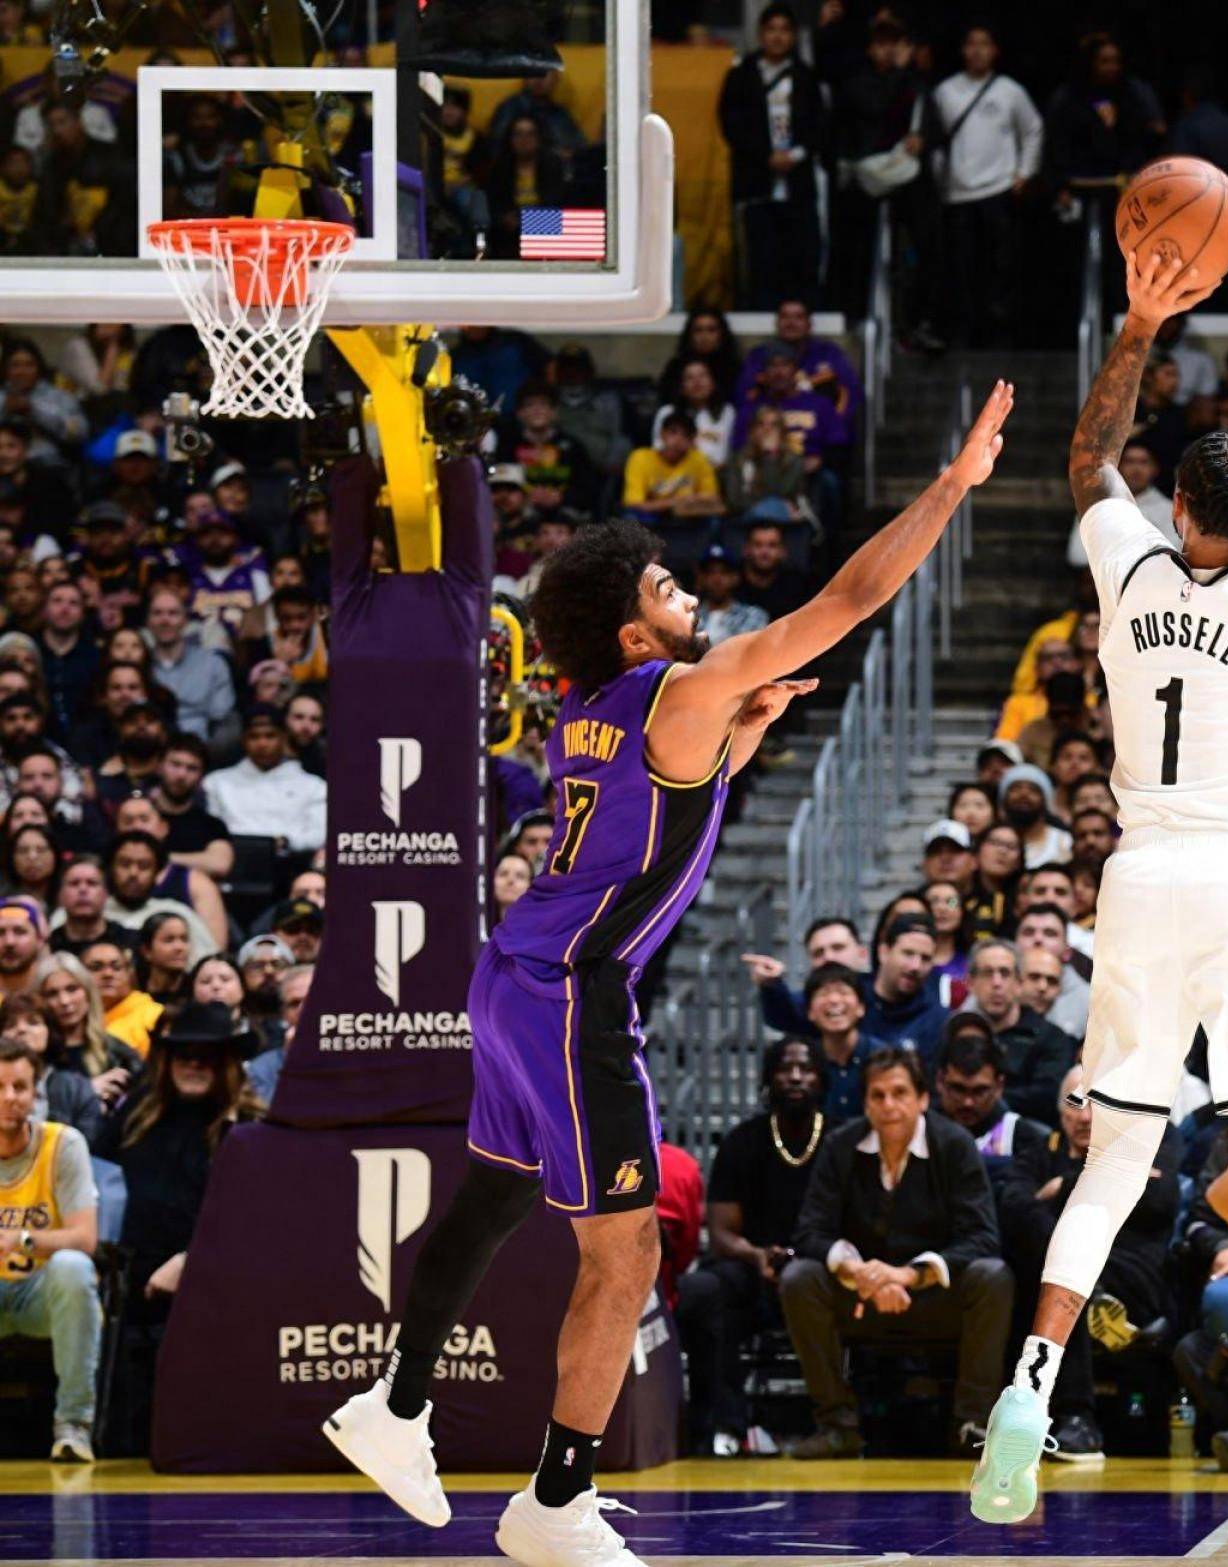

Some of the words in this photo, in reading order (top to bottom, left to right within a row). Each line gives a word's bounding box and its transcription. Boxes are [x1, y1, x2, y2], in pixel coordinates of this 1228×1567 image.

[563, 718, 626, 764] VINCENT
[1155, 677, 1184, 785] 1
[550, 777, 599, 876] 7
[337, 832, 459, 851] PECHANGA
[337, 852, 397, 865] RESORT
[319, 1011, 473, 1036] PECHANGA
[319, 1035, 394, 1051] RESORT
[403, 1034, 474, 1049] CASINO
[279, 1322, 496, 1358] PECHGA
[280, 1358, 384, 1383] RESORT
[433, 1356, 498, 1382] SINO
